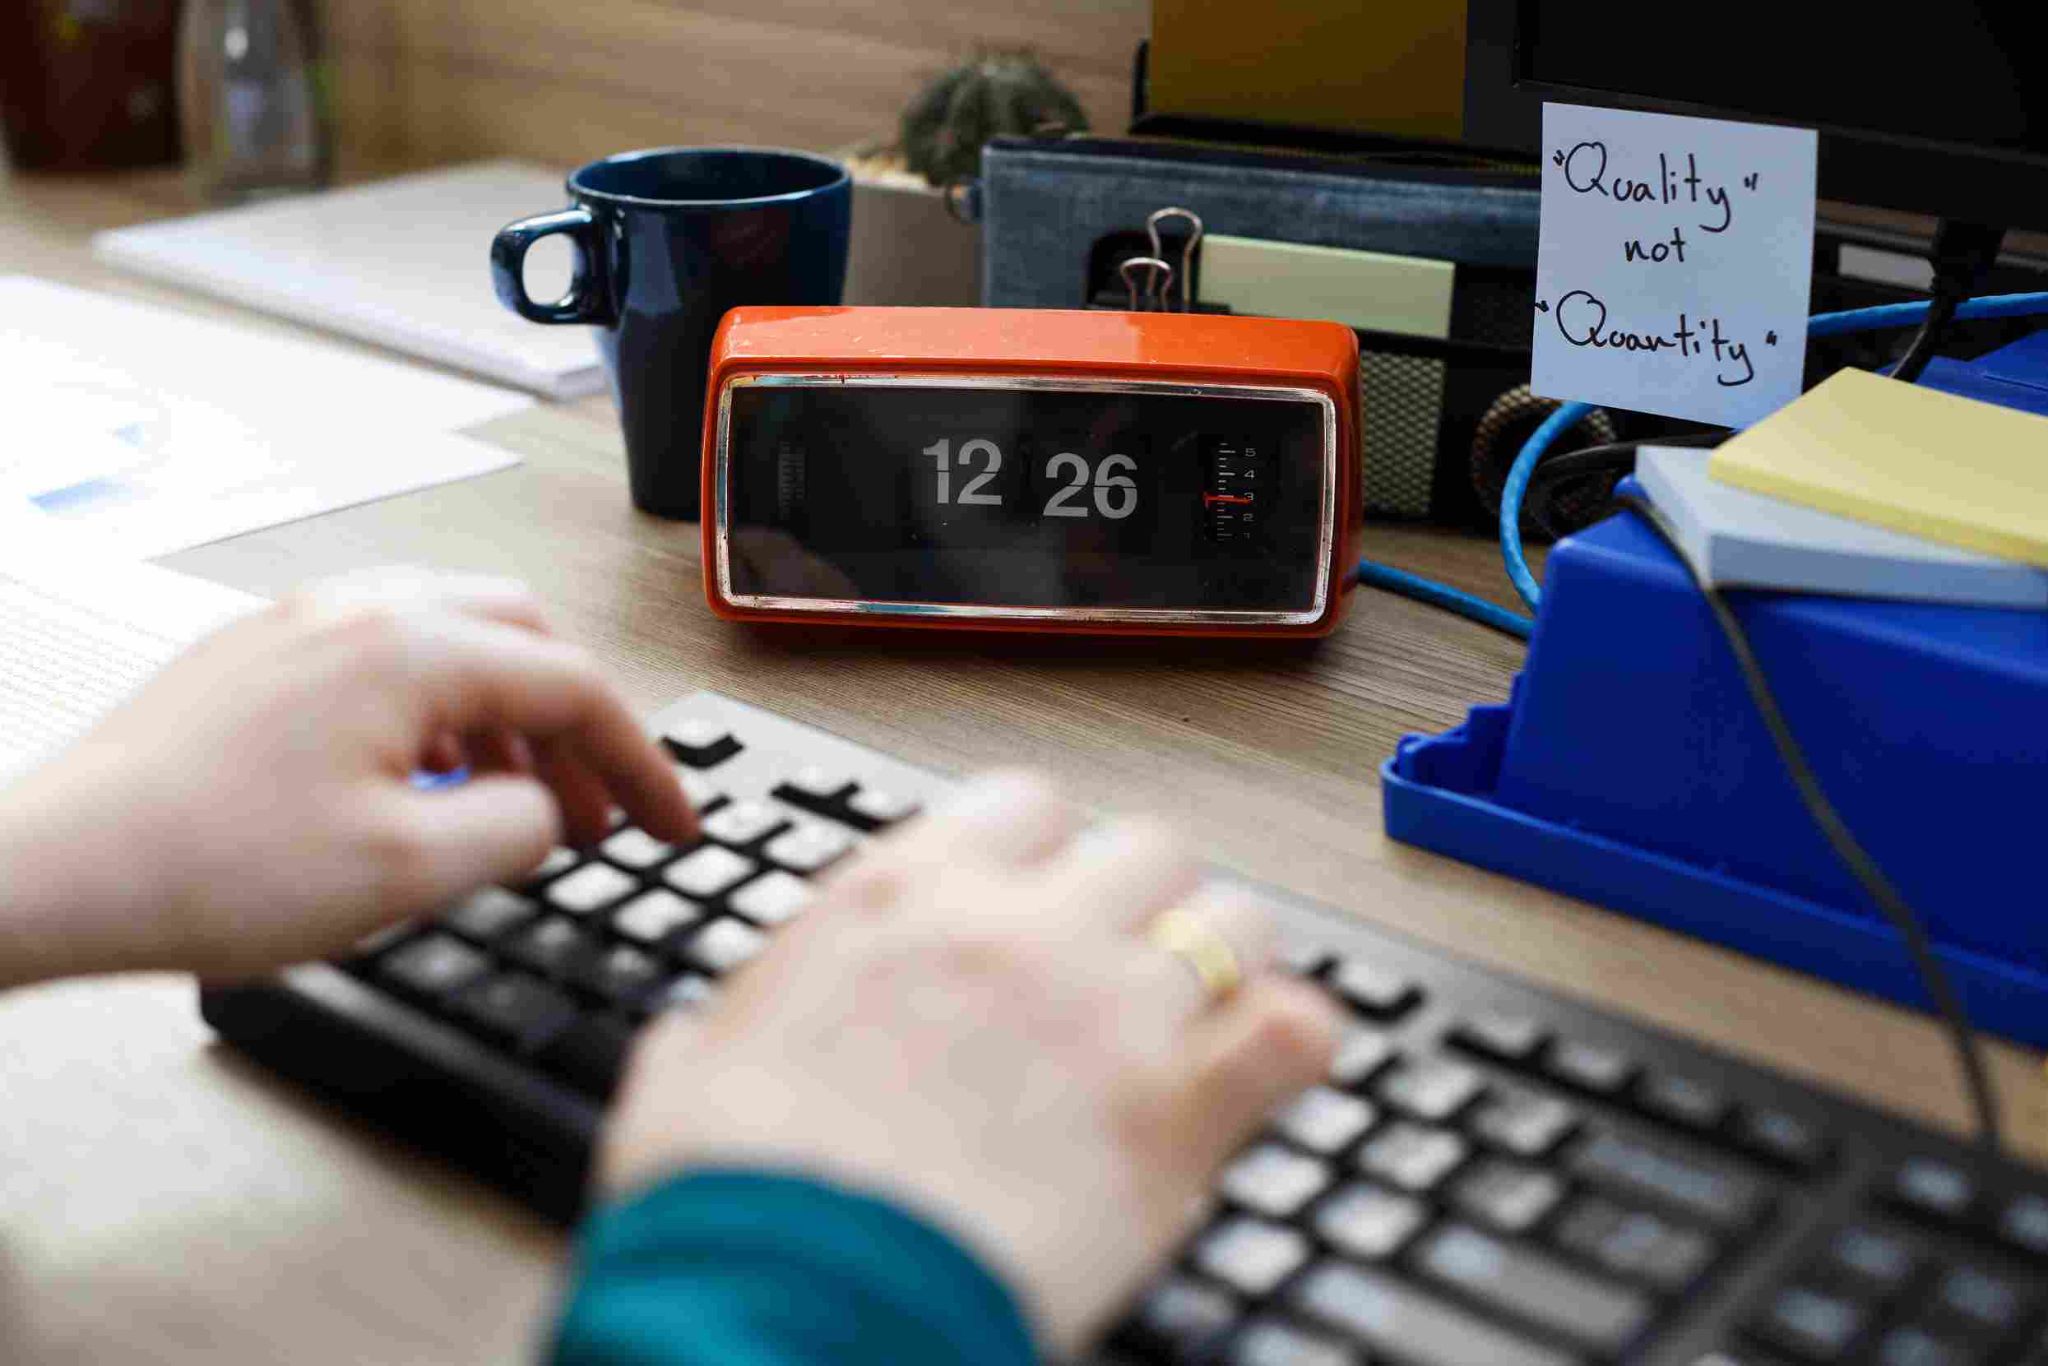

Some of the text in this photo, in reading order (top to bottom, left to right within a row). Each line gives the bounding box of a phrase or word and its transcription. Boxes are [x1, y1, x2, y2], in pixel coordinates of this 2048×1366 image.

[1624, 226, 1686, 263] not
[1245, 447, 1256, 457] 5
[923, 438, 1138, 519] 12 26
[1244, 469, 1255, 480] 4
[1243, 513, 1254, 522] 2
